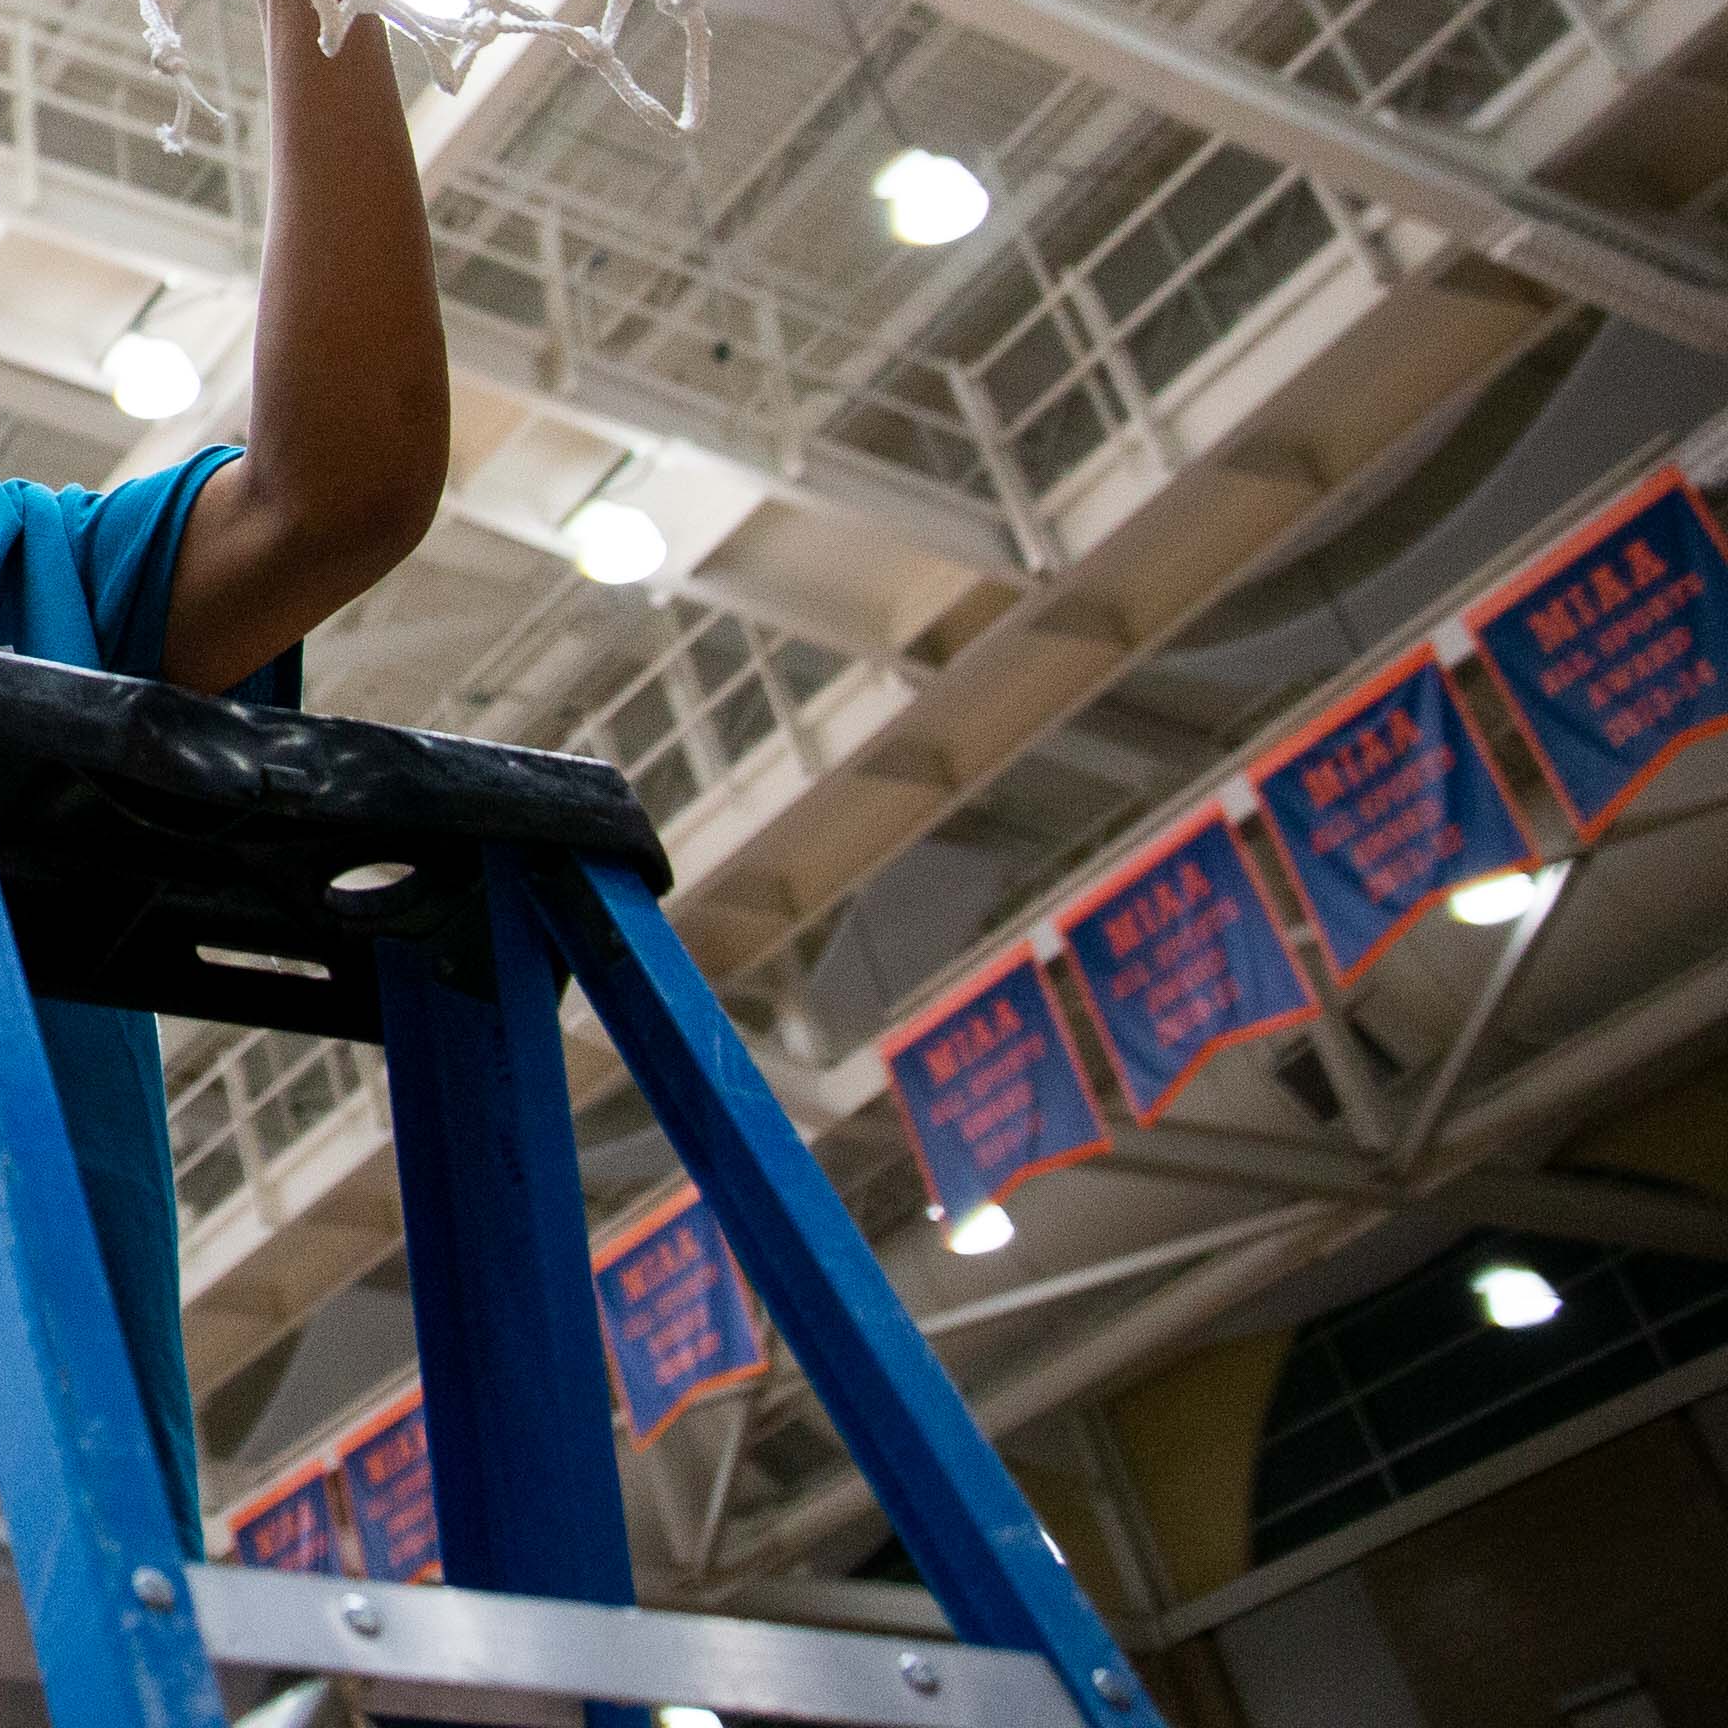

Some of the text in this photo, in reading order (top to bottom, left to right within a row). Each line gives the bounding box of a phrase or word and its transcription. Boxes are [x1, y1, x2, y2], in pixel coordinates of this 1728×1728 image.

[1526, 537, 1668, 654] MIAA
[1301, 707, 1422, 810] MIAA
[1104, 862, 1212, 957] MIAA
[925, 998, 1024, 1088] MIAA
